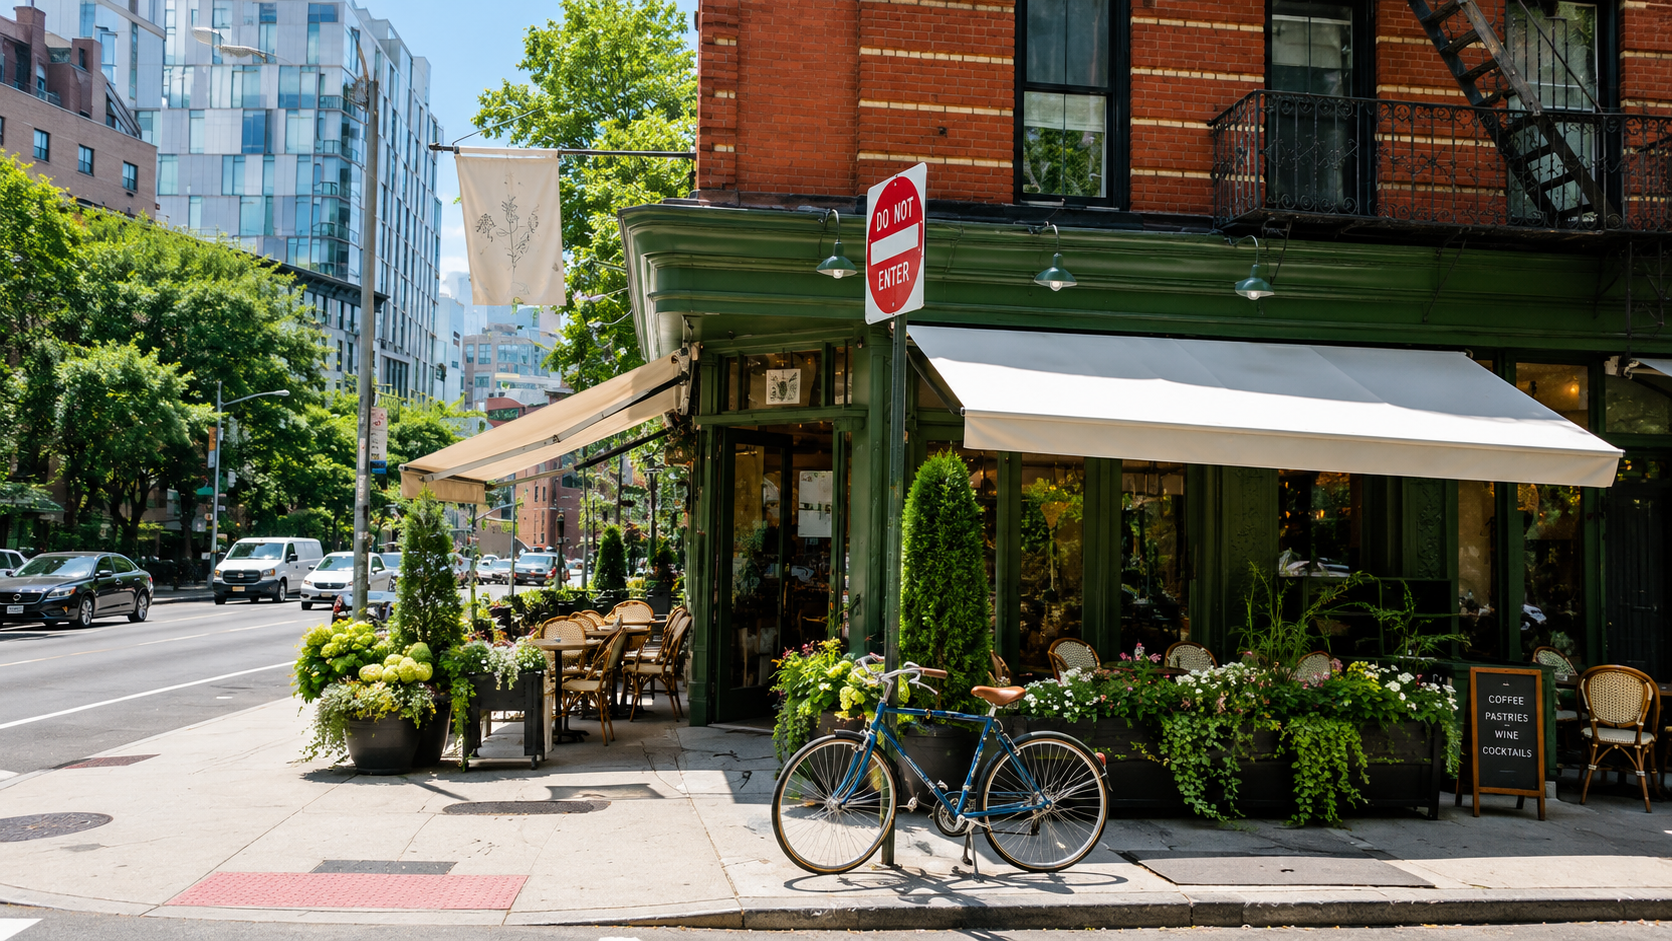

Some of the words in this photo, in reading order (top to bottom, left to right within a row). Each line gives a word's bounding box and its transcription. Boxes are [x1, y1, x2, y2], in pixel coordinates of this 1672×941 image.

[876, 208, 889, 232] DO
[893, 196, 914, 225] NOT
[878, 261, 909, 292] ENTER
[1488, 695, 1524, 705] COFFEE
[1485, 712, 1529, 722] PASTRIES
[1494, 730, 1519, 740] WINE
[1482, 746, 1532, 758] COCKTAILS
